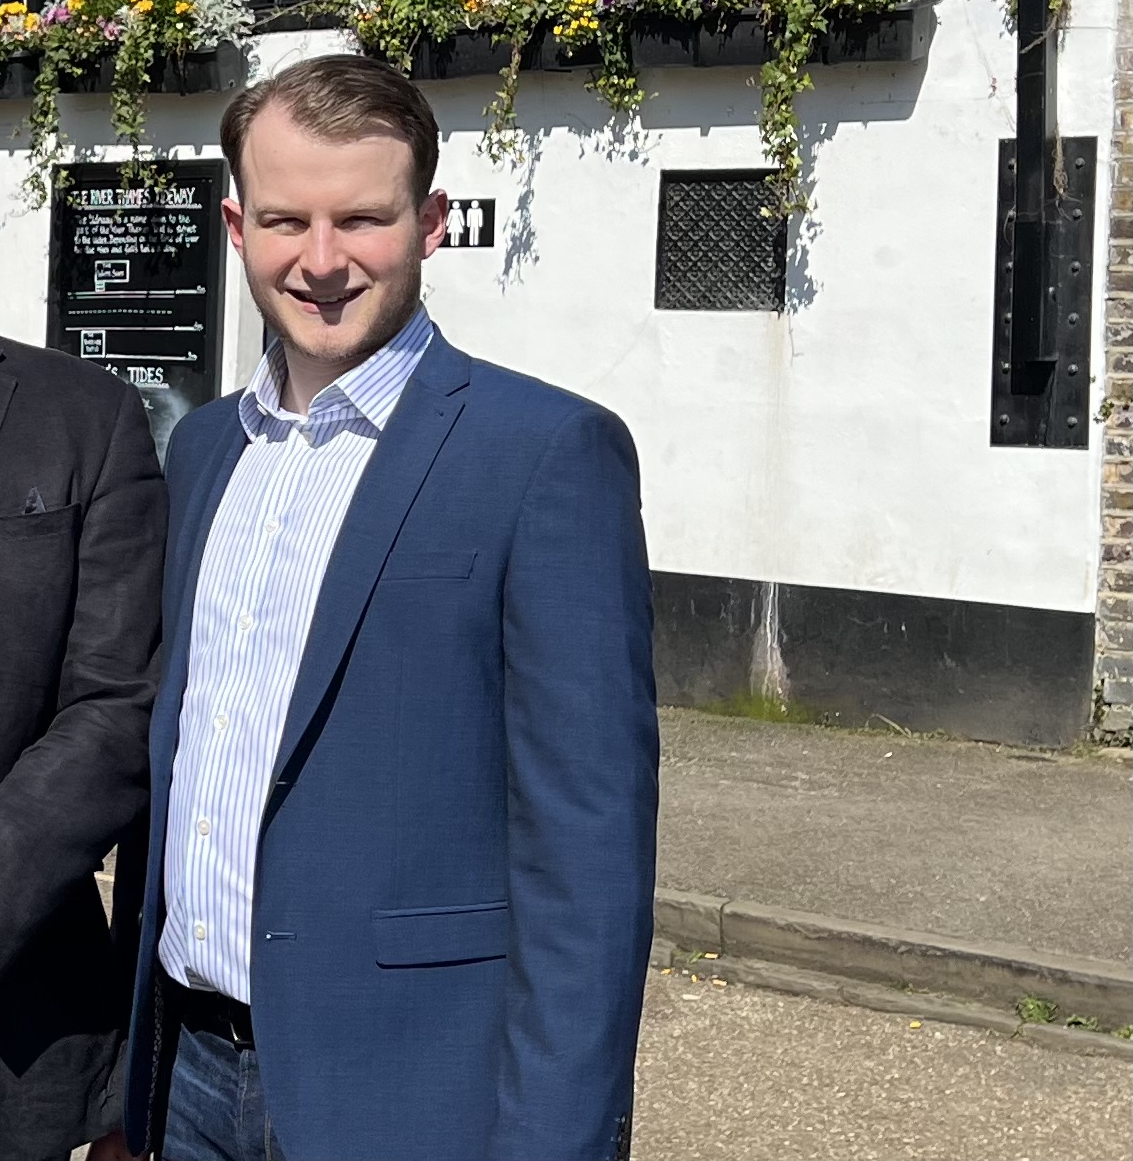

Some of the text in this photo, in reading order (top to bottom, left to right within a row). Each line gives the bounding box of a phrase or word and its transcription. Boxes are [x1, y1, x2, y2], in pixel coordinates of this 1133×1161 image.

[71, 190, 89, 205] TE
[90, 188, 113, 205] RIVER
[126, 366, 164, 384] TIDES
